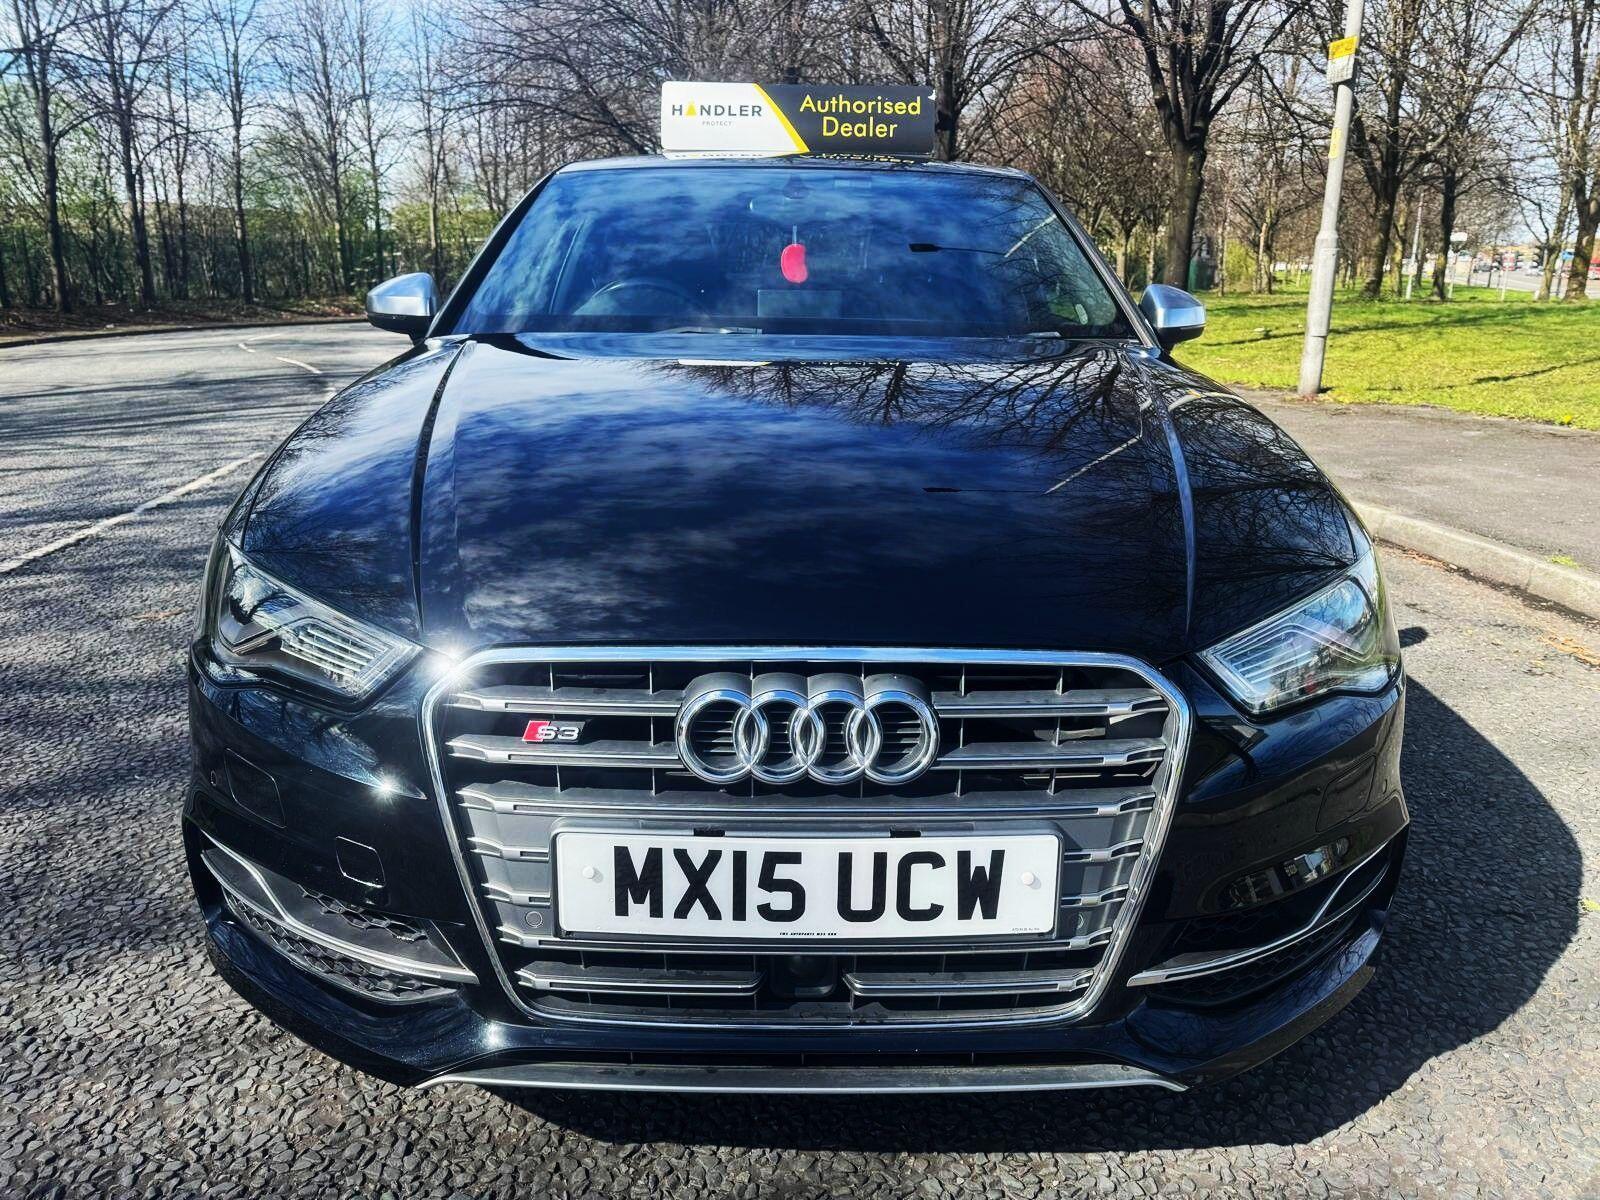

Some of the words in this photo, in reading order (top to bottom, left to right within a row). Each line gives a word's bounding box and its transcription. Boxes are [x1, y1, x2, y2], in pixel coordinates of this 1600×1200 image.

[671, 101, 762, 117] HANDLER
[799, 94, 921, 115] Authorised
[822, 116, 898, 138] Dealer
[536, 725, 579, 740] S3
[613, 845, 806, 922] MX15
[836, 849, 1006, 923] UCW
